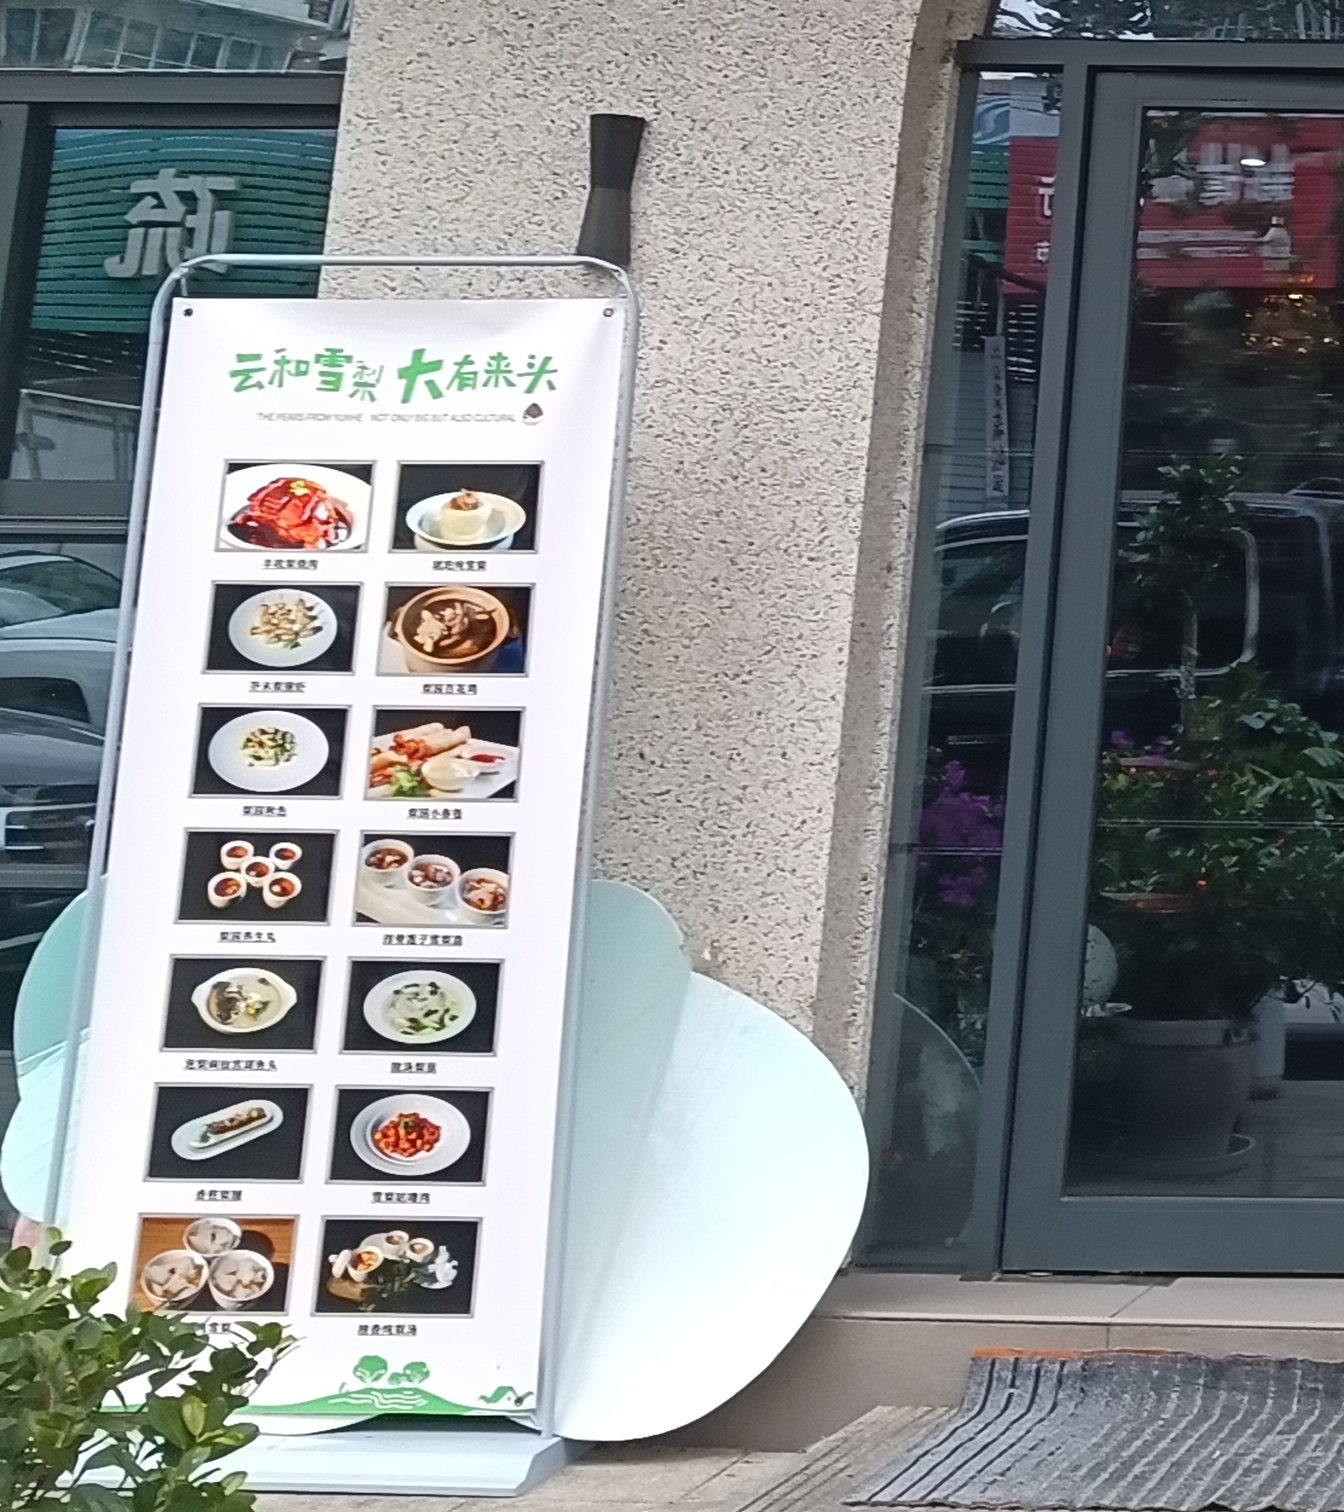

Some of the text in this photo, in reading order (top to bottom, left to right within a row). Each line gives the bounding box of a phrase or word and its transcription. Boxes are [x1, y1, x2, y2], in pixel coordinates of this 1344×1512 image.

[228, 346, 558, 404] 云和雪梨 大有来头
